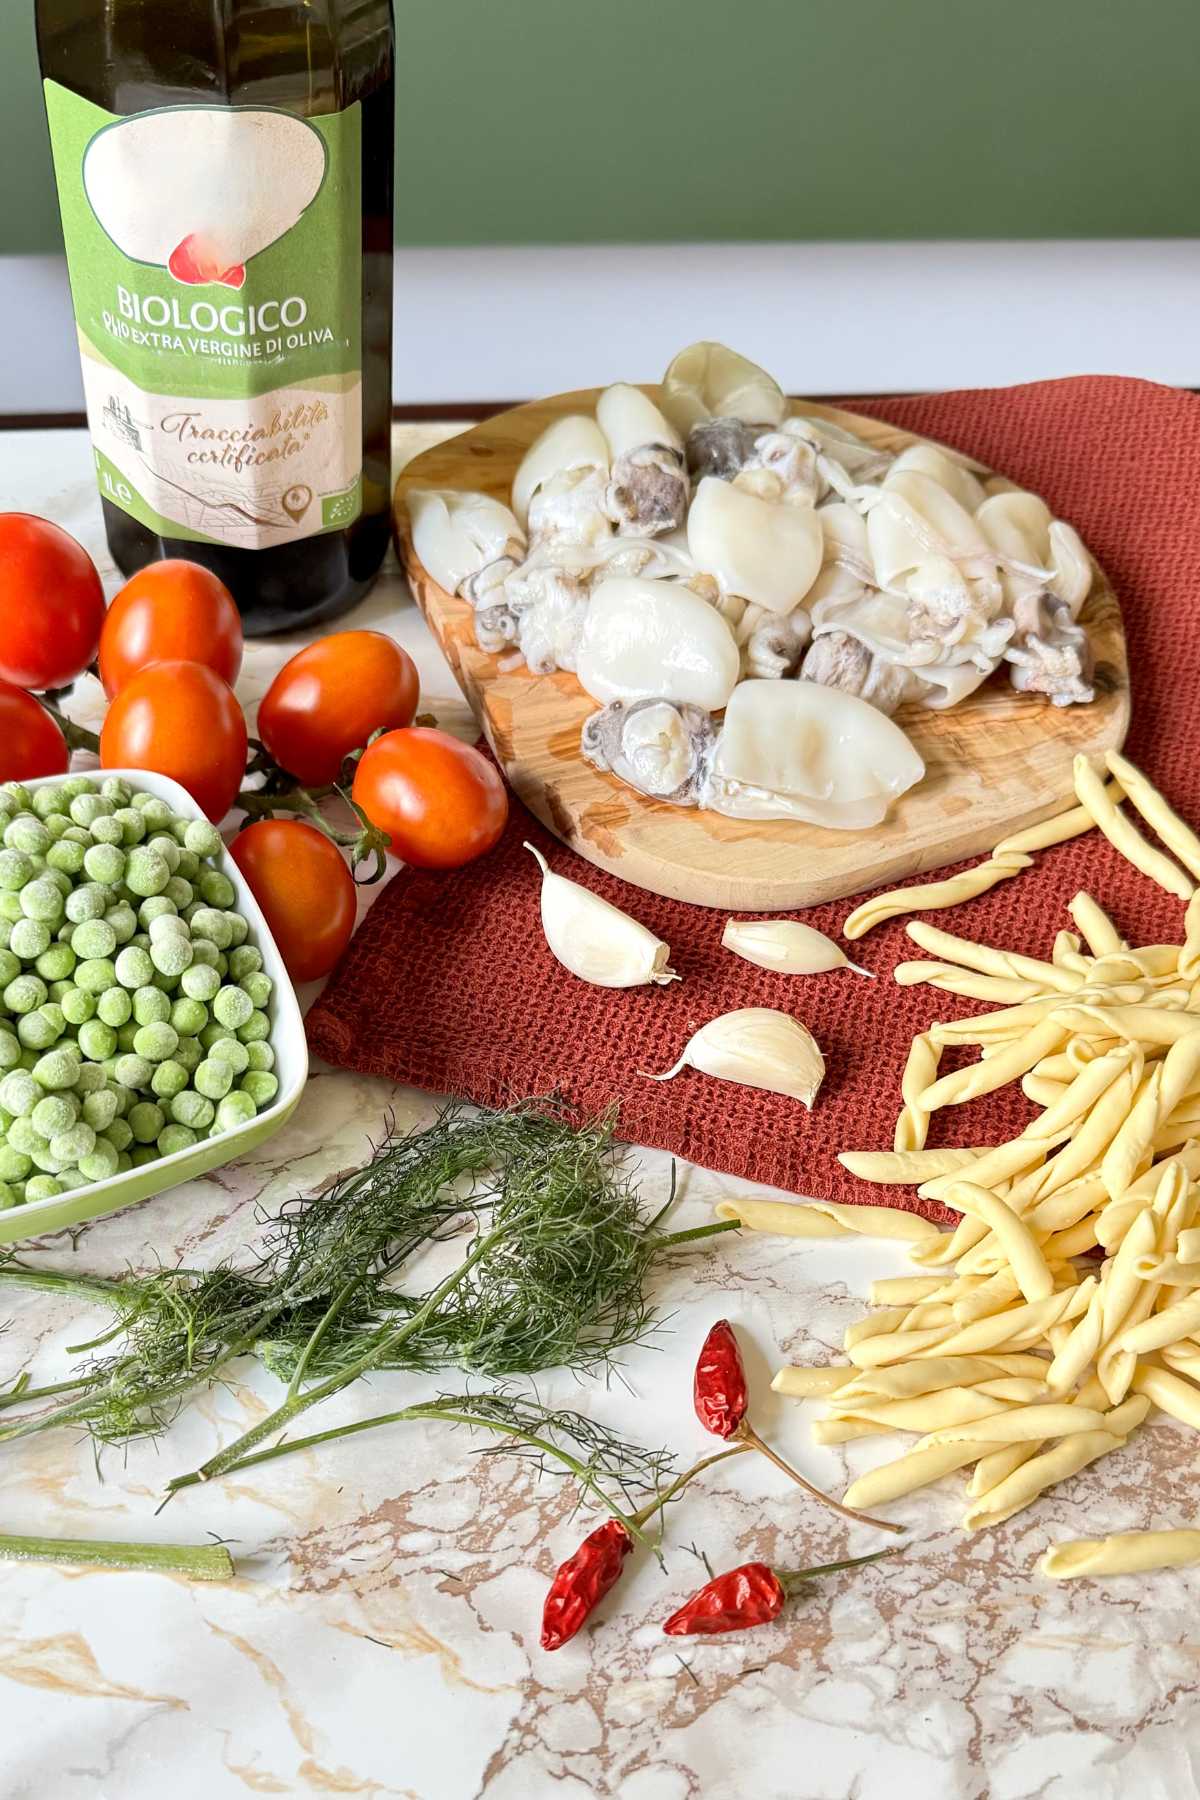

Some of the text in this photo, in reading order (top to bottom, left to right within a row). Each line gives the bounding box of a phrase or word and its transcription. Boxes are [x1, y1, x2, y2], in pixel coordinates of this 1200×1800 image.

[117, 284, 307, 336] BIOLOGICO
[131, 327, 185, 352] EXTRA
[188, 336, 262, 358] VERGINE
[266, 337, 282, 354] DI
[286, 327, 334, 349] OLIVA
